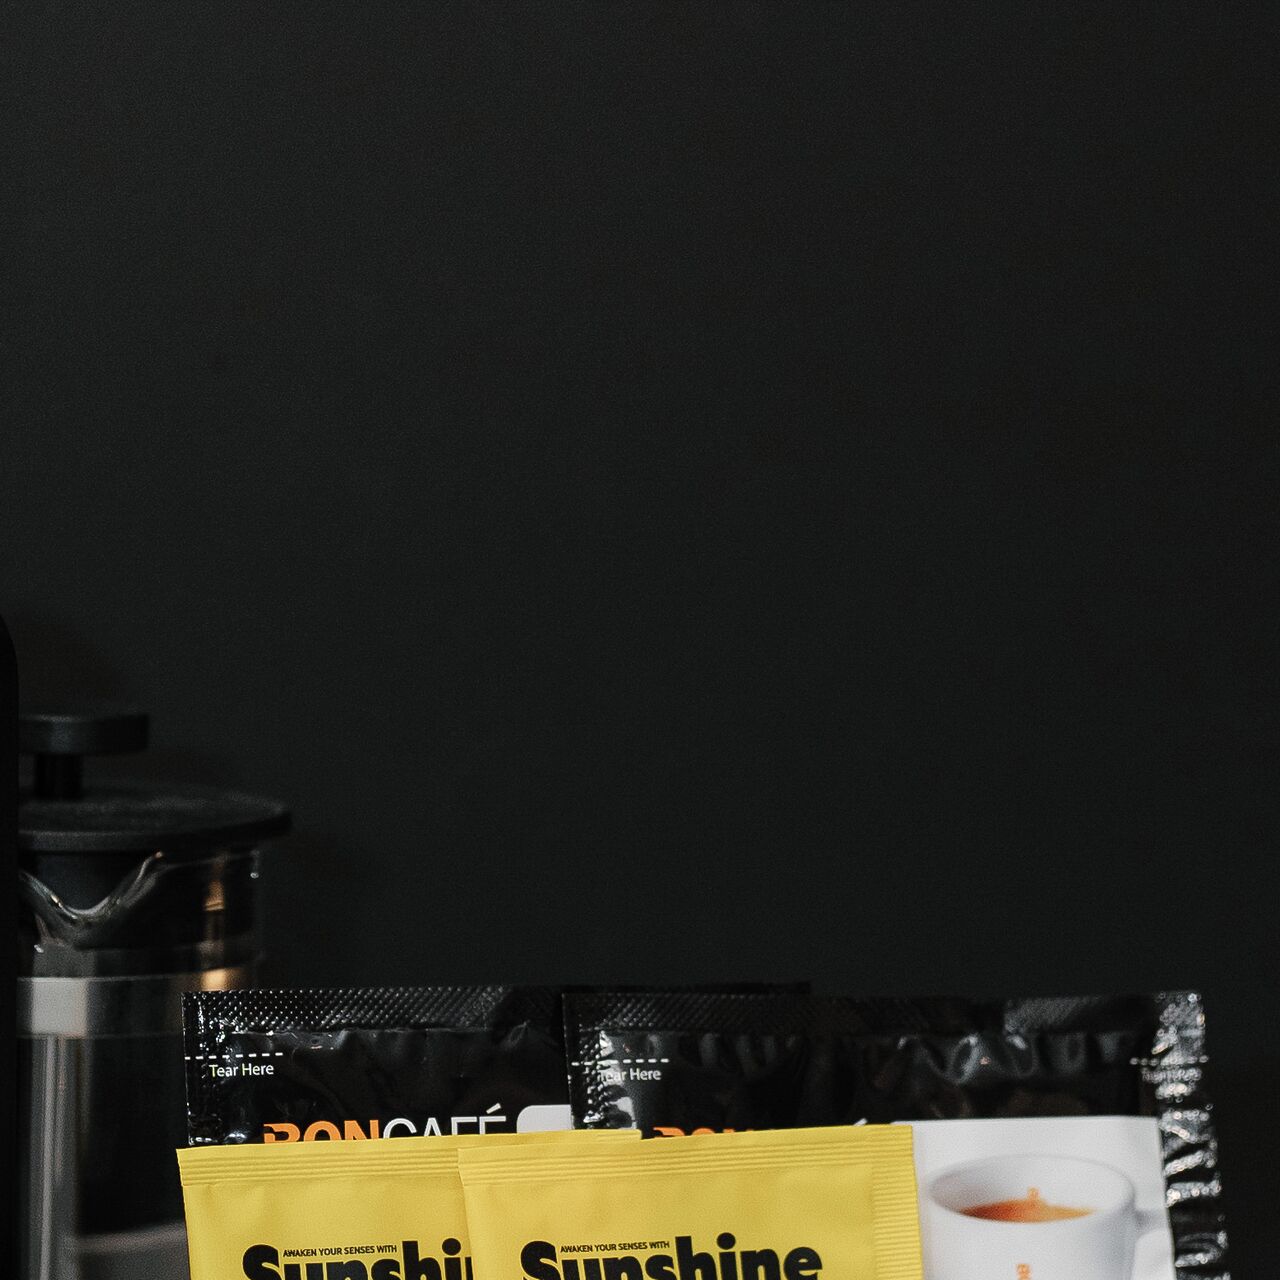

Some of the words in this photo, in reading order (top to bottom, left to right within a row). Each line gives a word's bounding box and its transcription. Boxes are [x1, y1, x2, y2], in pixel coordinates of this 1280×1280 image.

[208, 1063, 238, 1077] Tear
[242, 1063, 274, 1077] Here
[629, 1067, 662, 1081] Here
[283, 1248, 317, 1257] AWAKEN
[319, 1247, 342, 1256] YOUR
[344, 1245, 375, 1255] SENSES
[376, 1244, 397, 1254] WITH
[560, 1245, 593, 1253] AWAKEN
[594, 1243, 617, 1252] YOUR
[618, 1241, 648, 1251] SENSES
[649, 1240, 670, 1250] WITH
